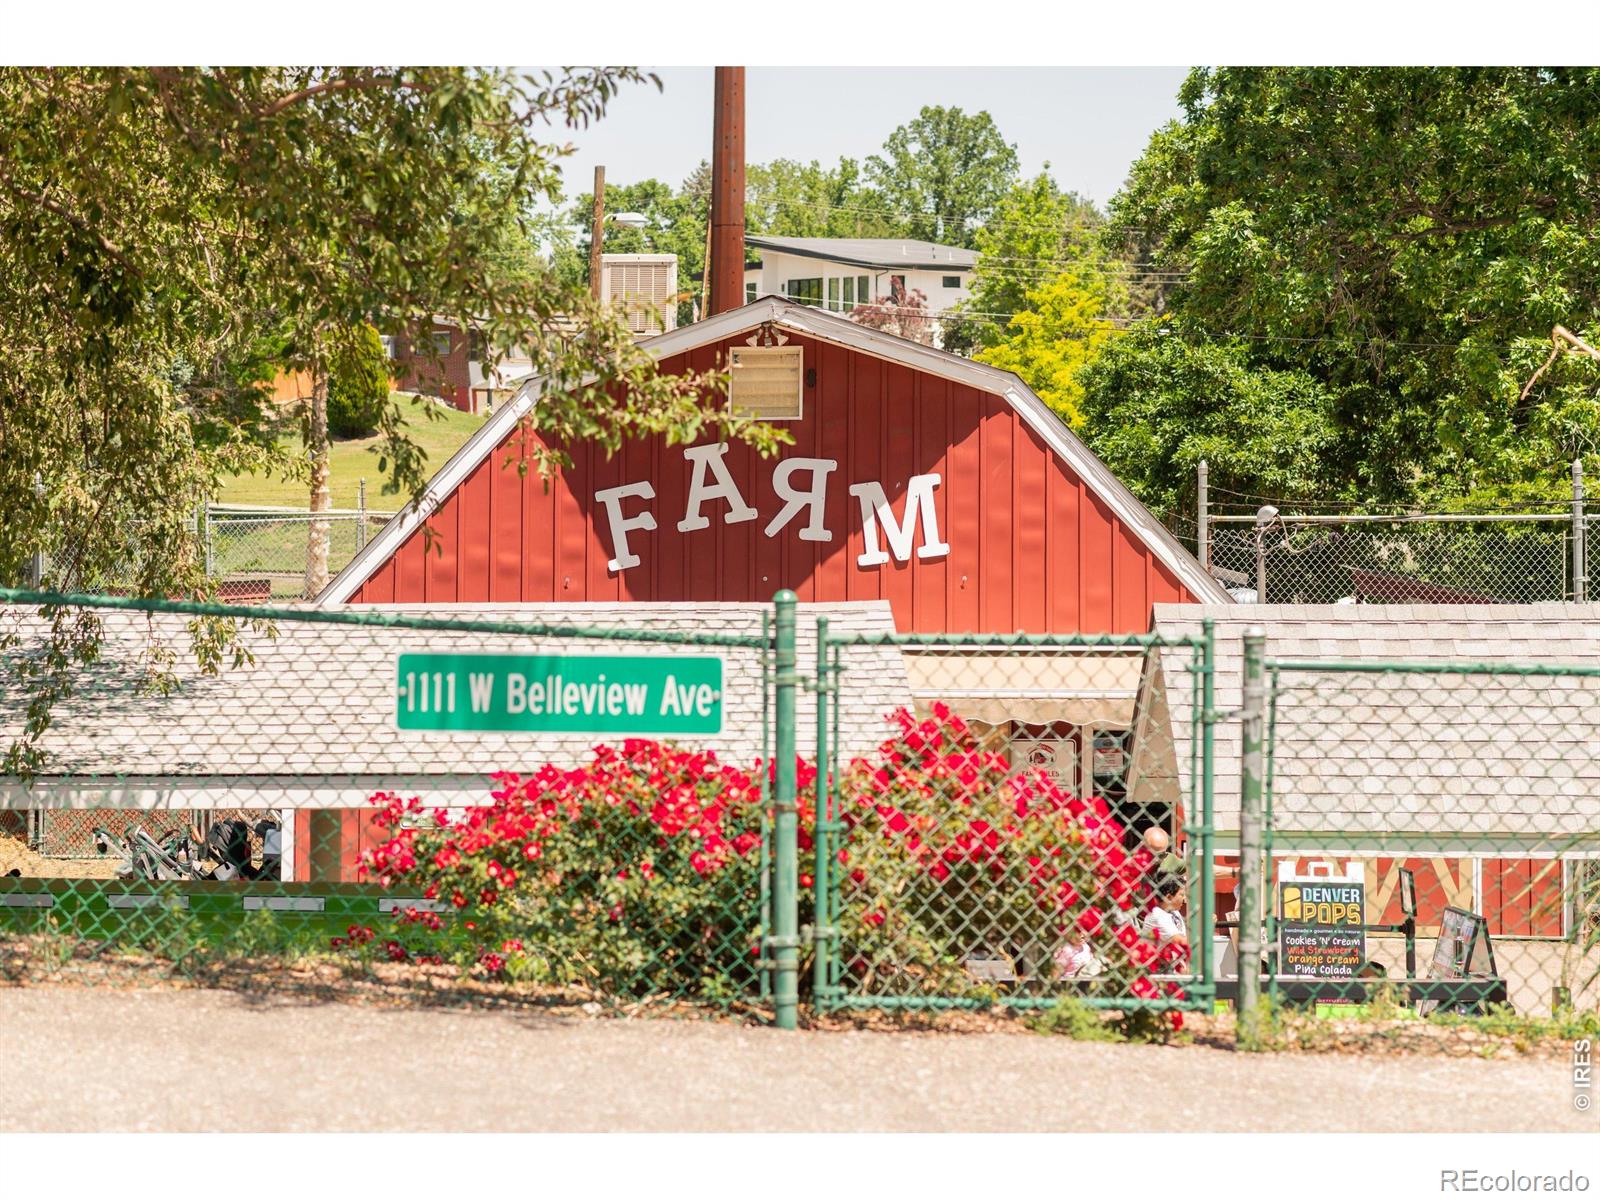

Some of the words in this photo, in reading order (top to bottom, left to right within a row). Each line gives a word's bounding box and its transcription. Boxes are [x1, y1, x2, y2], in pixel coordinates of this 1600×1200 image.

[406, 671, 456, 713] 1111
[469, 672, 494, 713] W
[506, 672, 648, 716] Belleview
[659, 674, 713, 717] Ave
[1302, 887, 1360, 903] DENVER
[1303, 902, 1361, 925] POPS
[1285, 935, 1317, 945] Cookies
[1332, 937, 1361, 946] Cream
[1319, 964, 1353, 975] Colada
